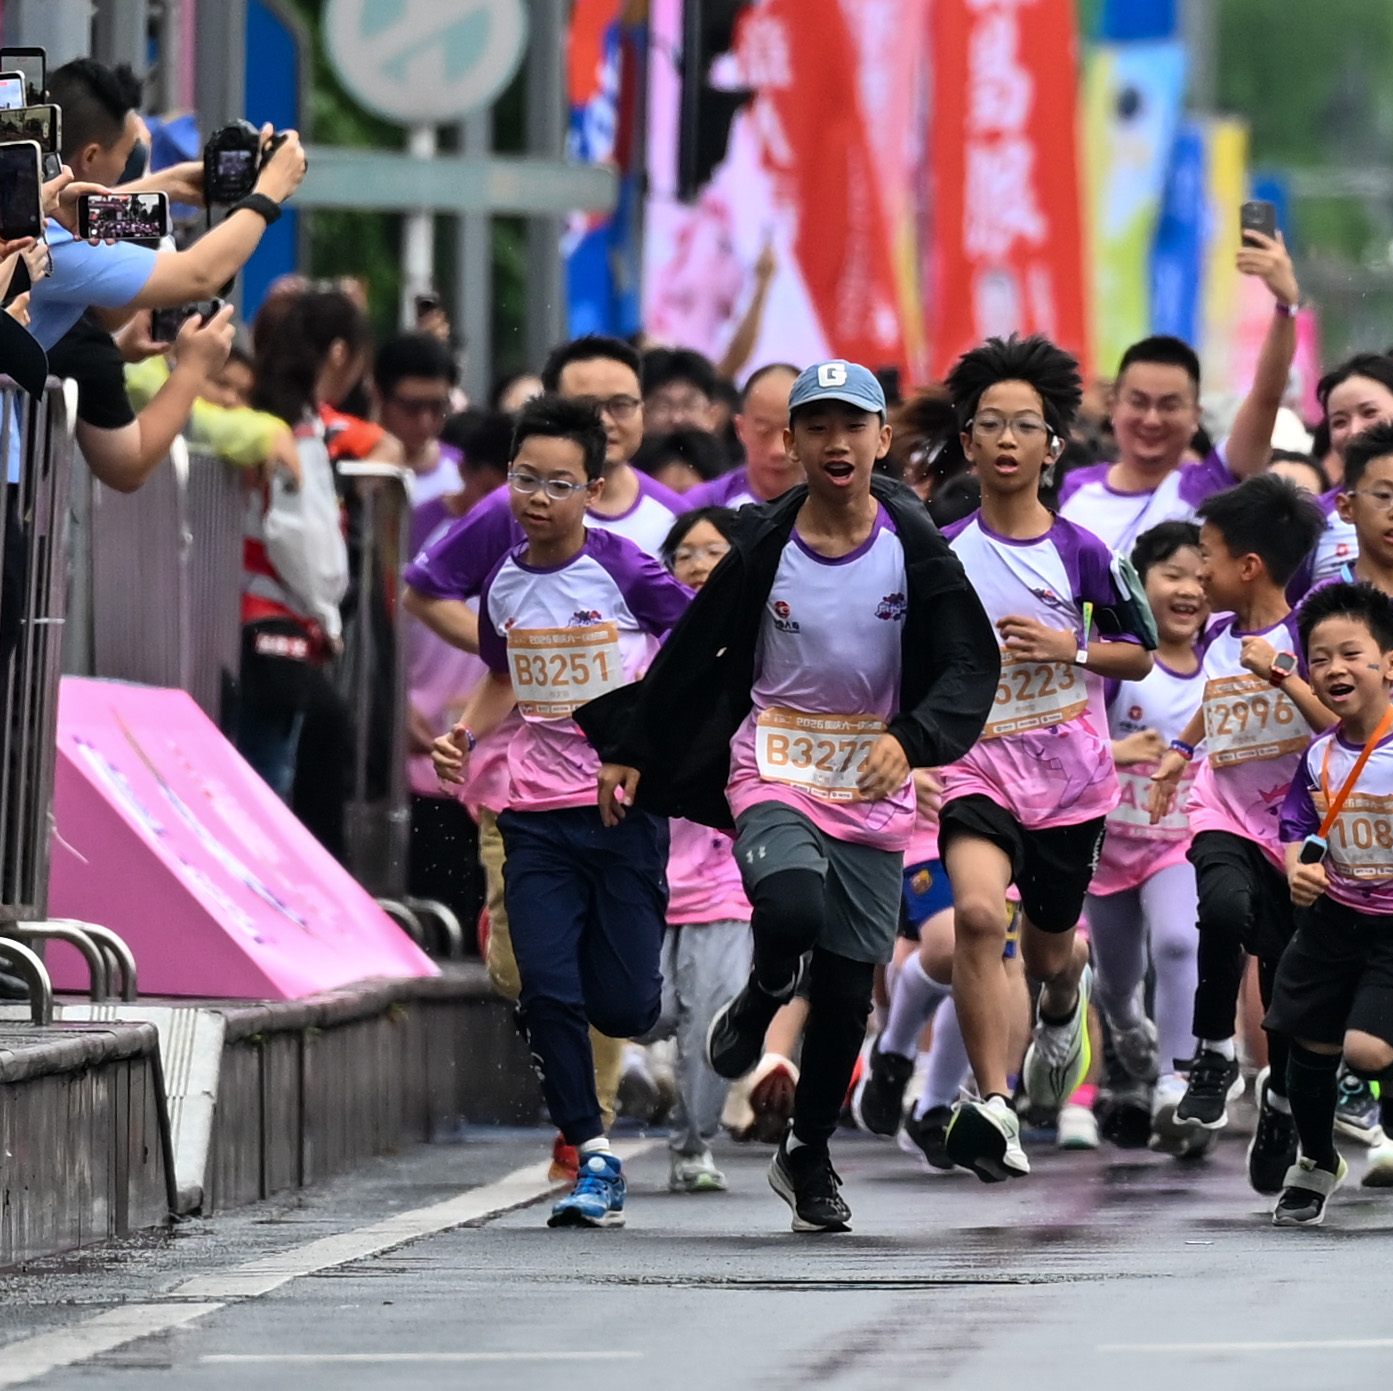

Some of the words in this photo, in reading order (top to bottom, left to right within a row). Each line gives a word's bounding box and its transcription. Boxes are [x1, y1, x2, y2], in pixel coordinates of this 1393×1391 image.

[817, 363, 848, 388] G
[513, 651, 609, 687] B3251
[994, 661, 1076, 706] 5223
